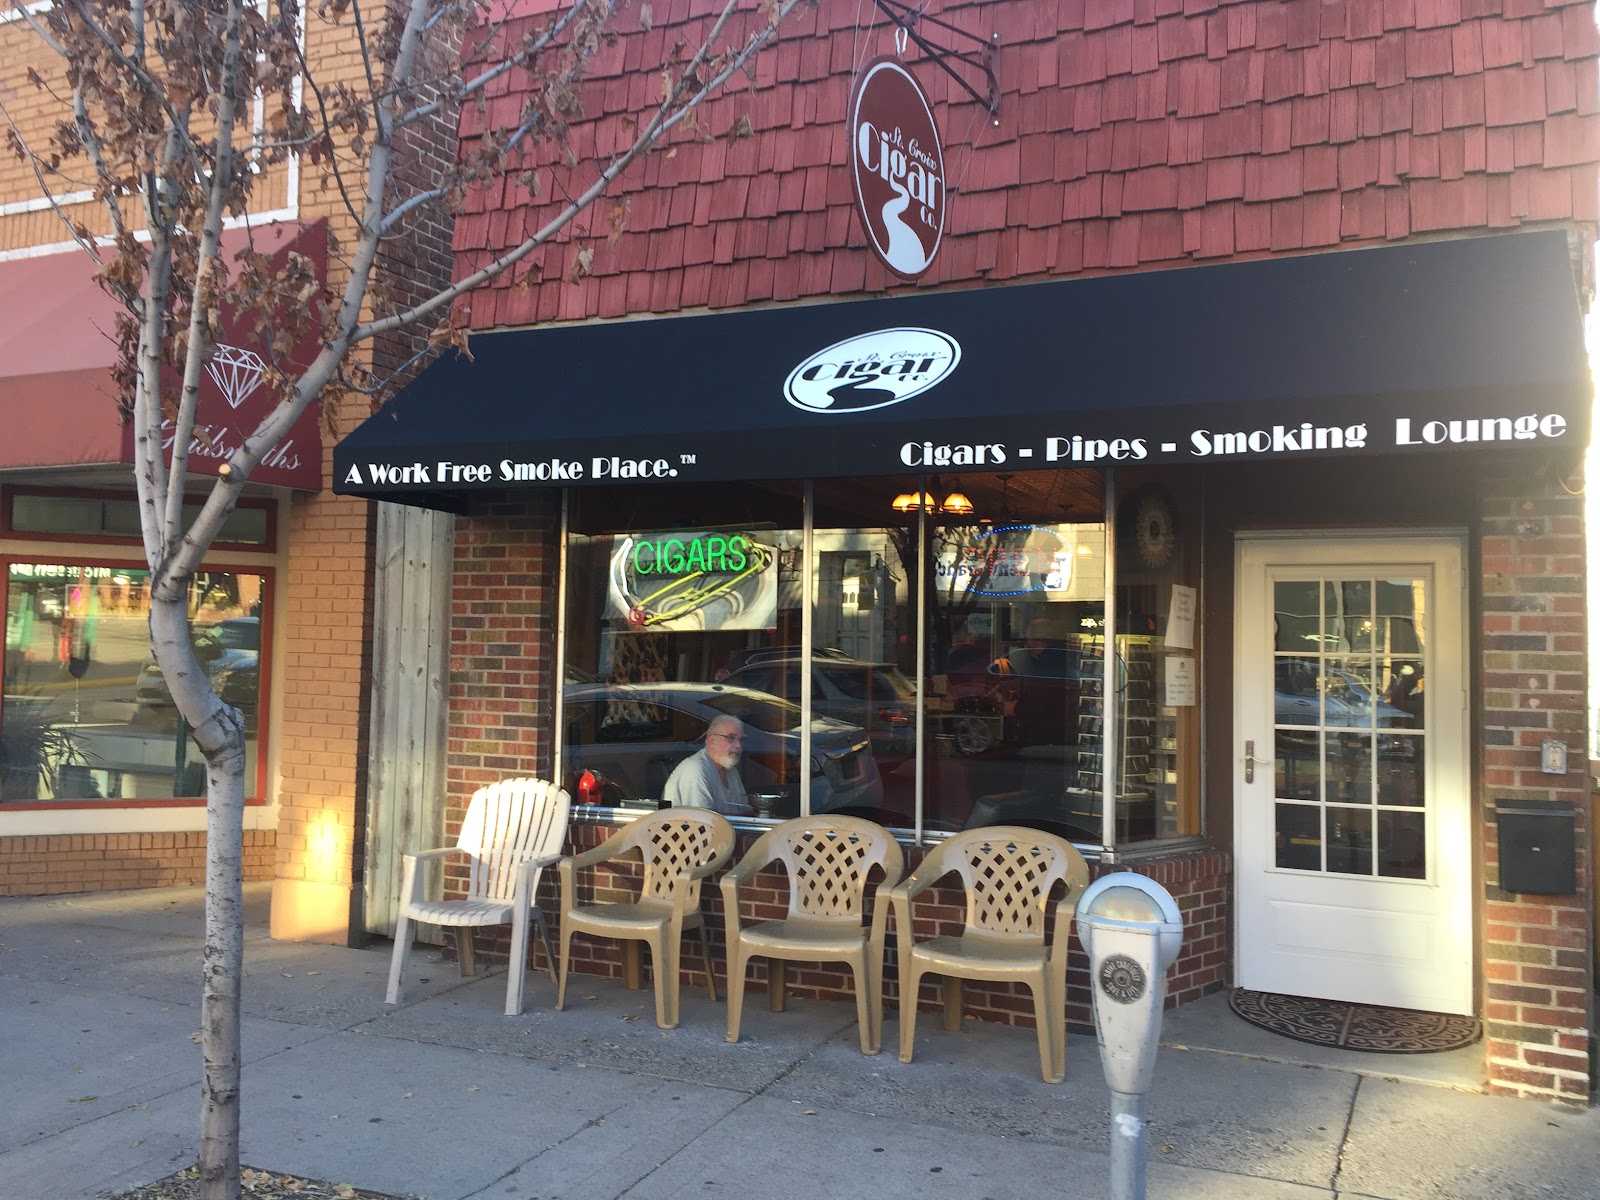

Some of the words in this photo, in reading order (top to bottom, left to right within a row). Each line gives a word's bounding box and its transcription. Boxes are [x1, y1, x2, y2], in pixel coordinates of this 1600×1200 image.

[859, 121, 941, 210] Cigar
[889, 126, 904, 150] St.
[908, 138, 937, 171] Croix
[802, 357, 947, 381] Cigar
[900, 441, 1007, 467] Cigars
[1045, 435, 1148, 462] Pipes
[1190, 422, 1368, 457] Smoking
[1395, 413, 1567, 445] Lounge
[344, 463, 363, 485] A
[368, 462, 431, 485] Work
[436, 462, 492, 484] Free
[499, 459, 583, 482] Smoke
[634, 536, 748, 575] CIGARS
[963, 546, 1058, 577] OPEN
